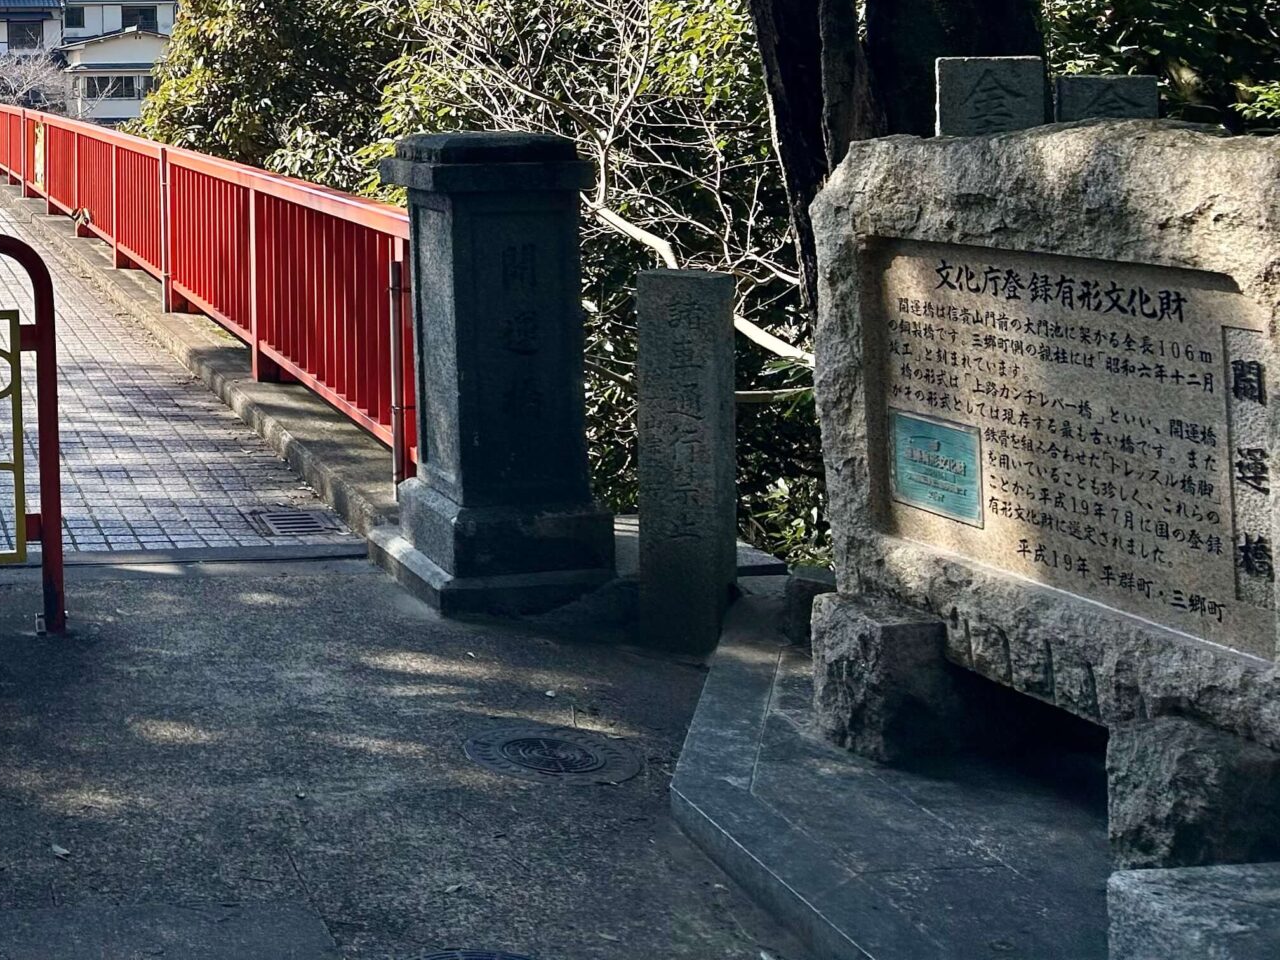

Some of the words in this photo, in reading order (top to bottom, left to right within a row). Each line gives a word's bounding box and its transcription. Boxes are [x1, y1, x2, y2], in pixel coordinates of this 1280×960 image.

[934, 260, 1188, 323] 文化庁登録有形文化財
[1231, 359, 1274, 582] 開運橋
[1017, 540, 1090, 578] 平成19年
